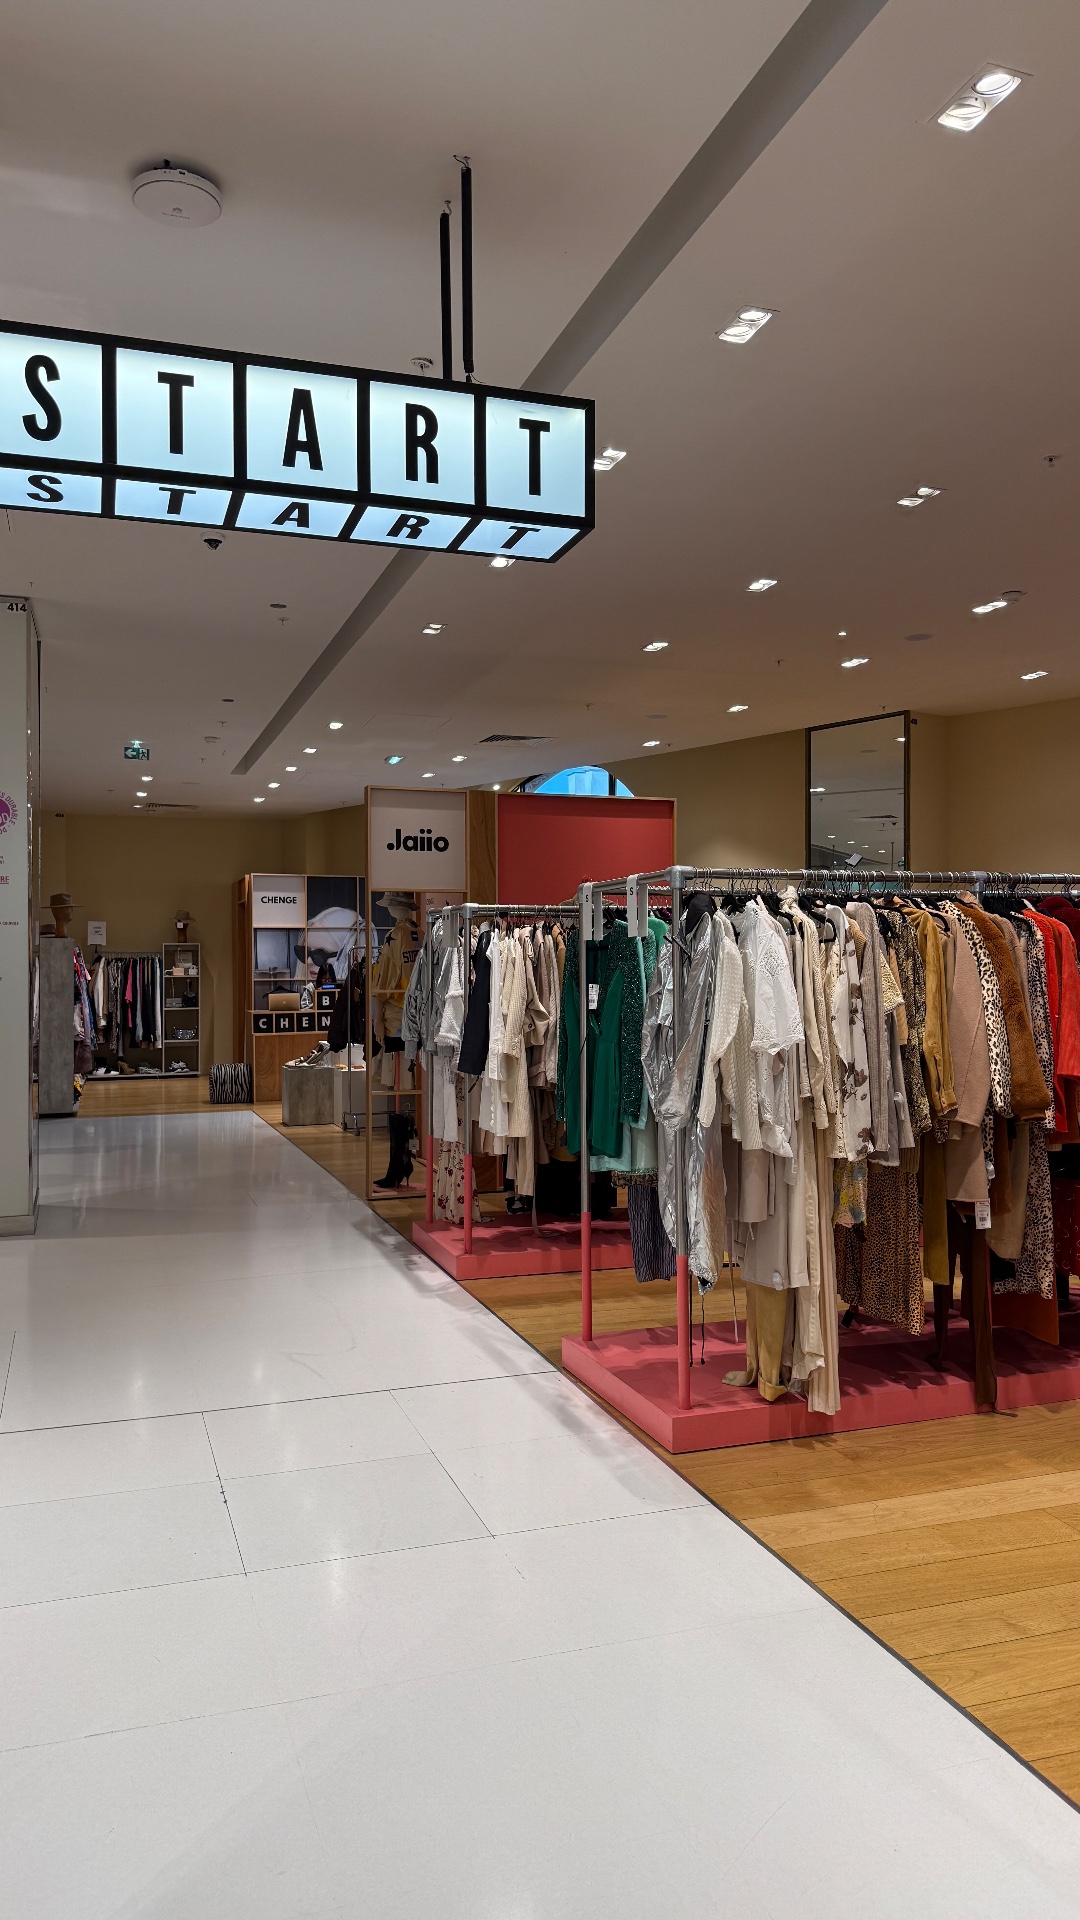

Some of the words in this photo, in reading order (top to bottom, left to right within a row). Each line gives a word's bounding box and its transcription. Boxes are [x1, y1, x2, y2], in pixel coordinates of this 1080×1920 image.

[22, 353, 551, 497] START
[27, 474, 540, 550] START
[7, 602, 27, 612] 414
[260, 896, 298, 904] CHENGE
